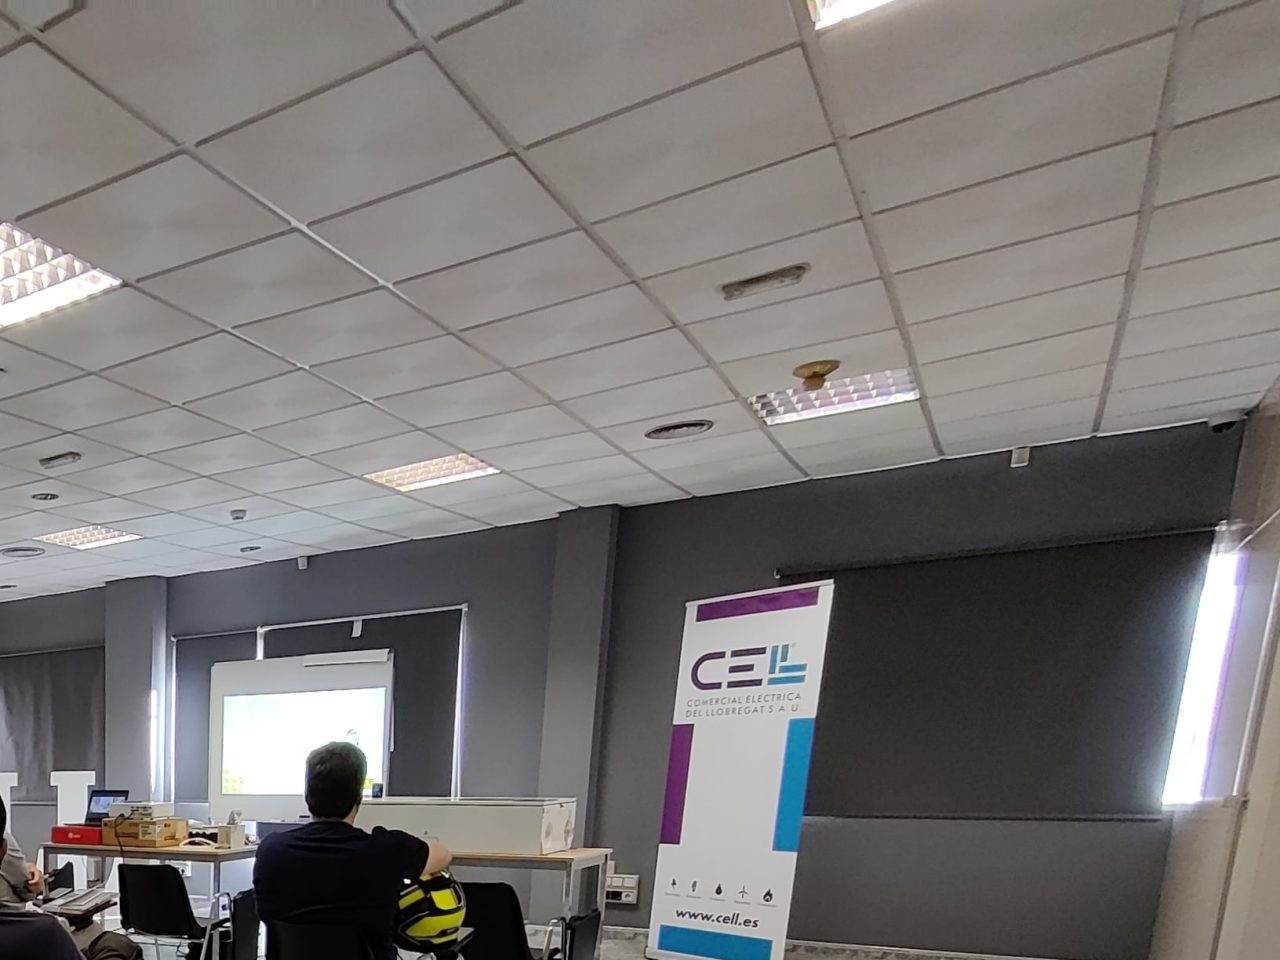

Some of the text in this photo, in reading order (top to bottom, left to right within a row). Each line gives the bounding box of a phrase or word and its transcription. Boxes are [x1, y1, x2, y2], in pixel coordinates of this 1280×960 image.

[690, 643, 808, 691] CELL
[686, 692, 801, 708] COMERCIAL ELECTRICA
[685, 709, 705, 718] DEL
[705, 705, 765, 717] LLOBREGAT
[675, 909, 760, 928] www.cell.es
